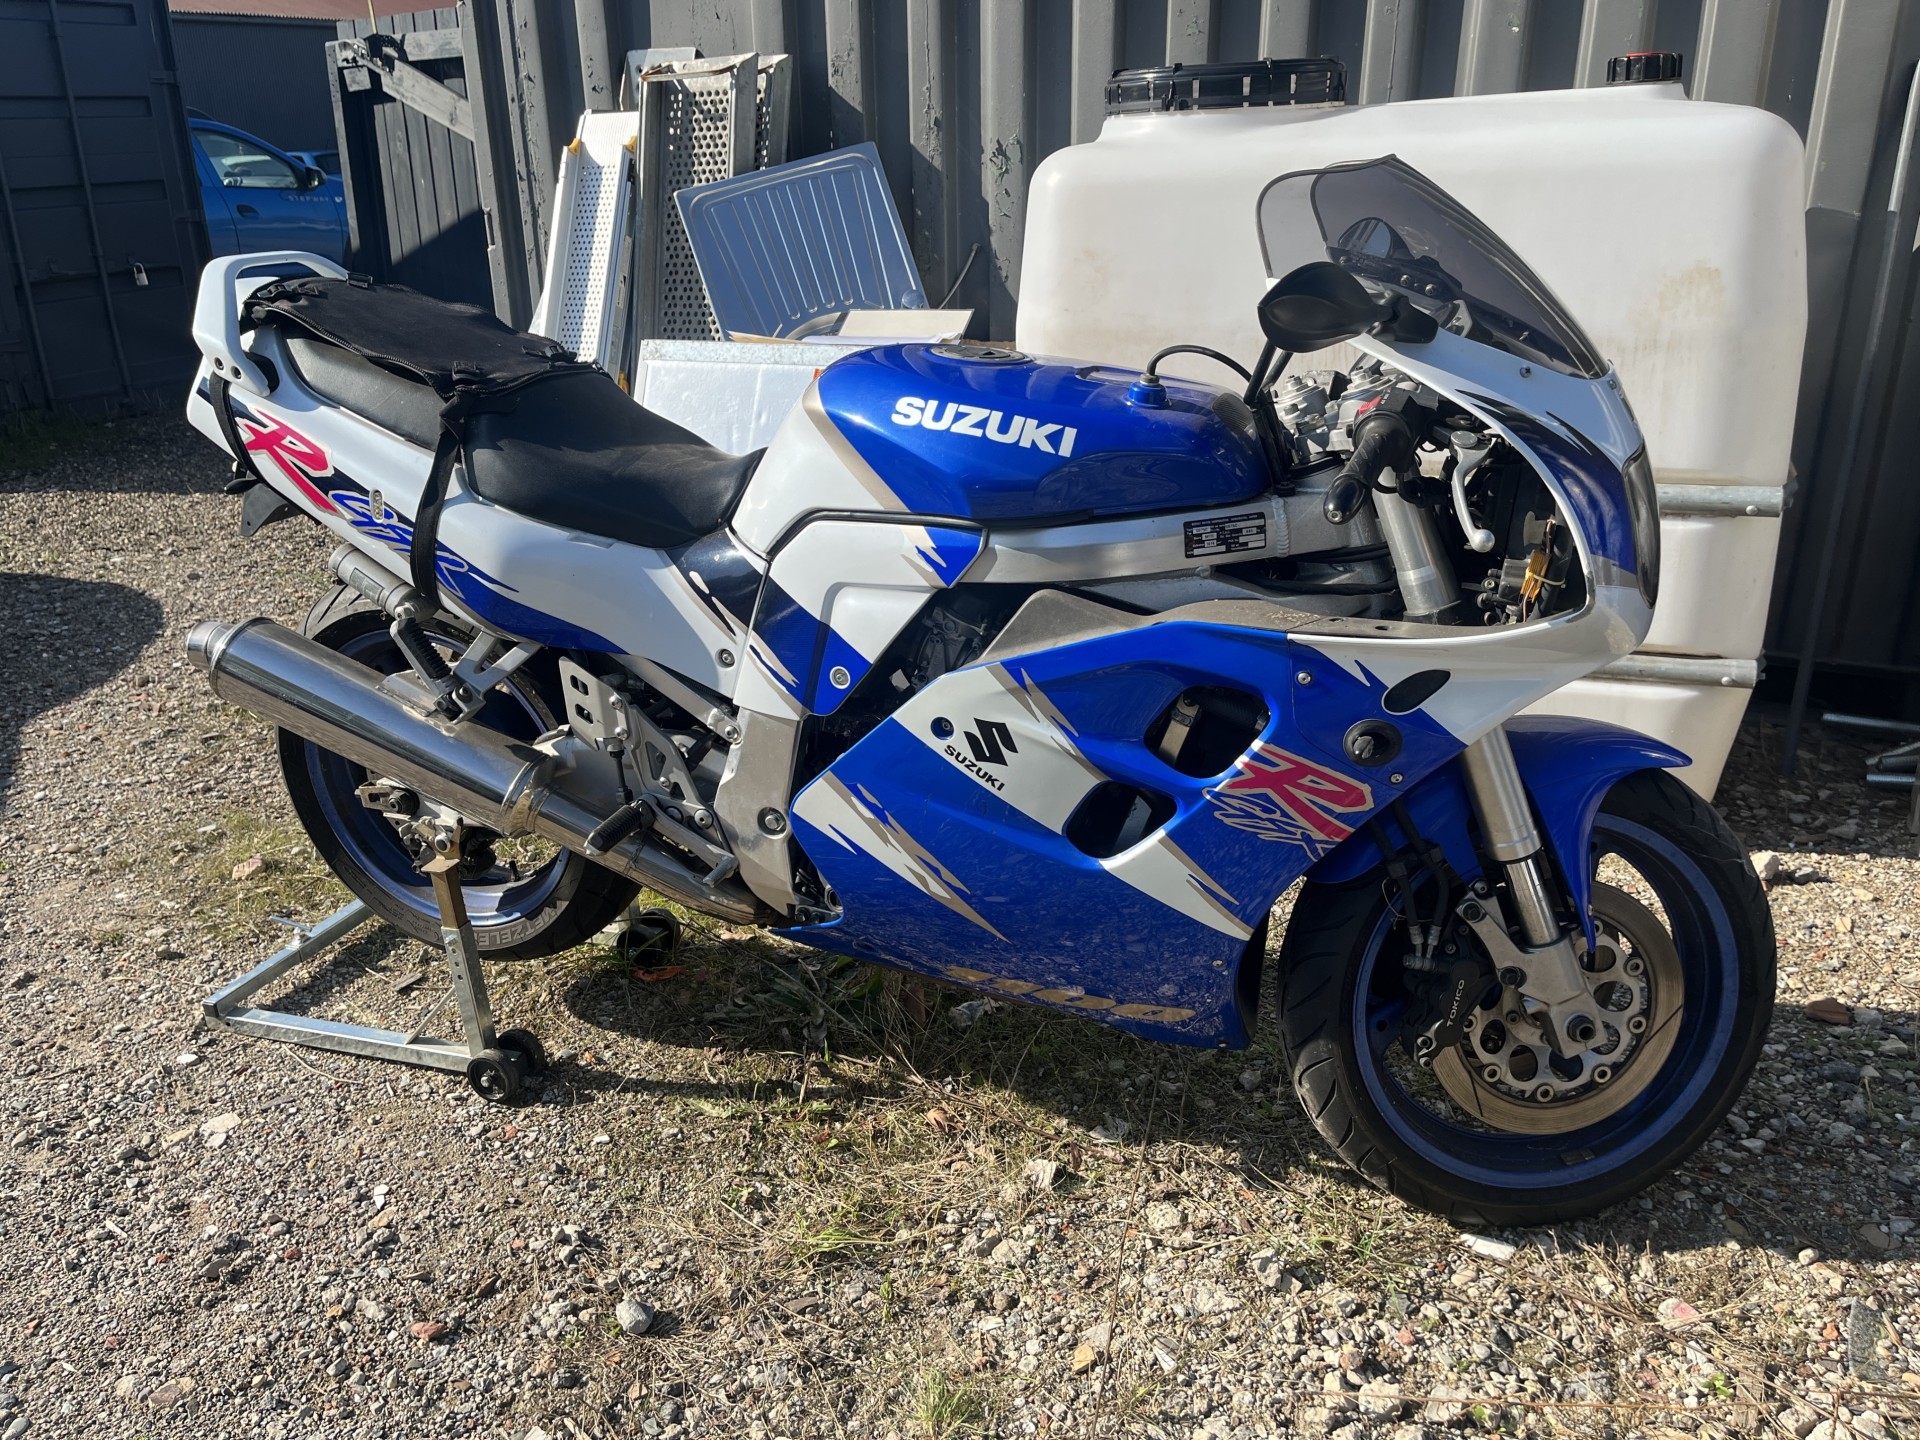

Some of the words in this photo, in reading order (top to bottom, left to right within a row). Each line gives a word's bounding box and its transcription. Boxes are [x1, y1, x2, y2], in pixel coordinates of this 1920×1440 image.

[891, 396, 1078, 458] SUZUKI
[944, 744, 1006, 792] SUZUKI
[1222, 742, 1374, 843] R
[474, 905, 558, 946] METZELE
[1446, 979, 1465, 1028] TOKICO
